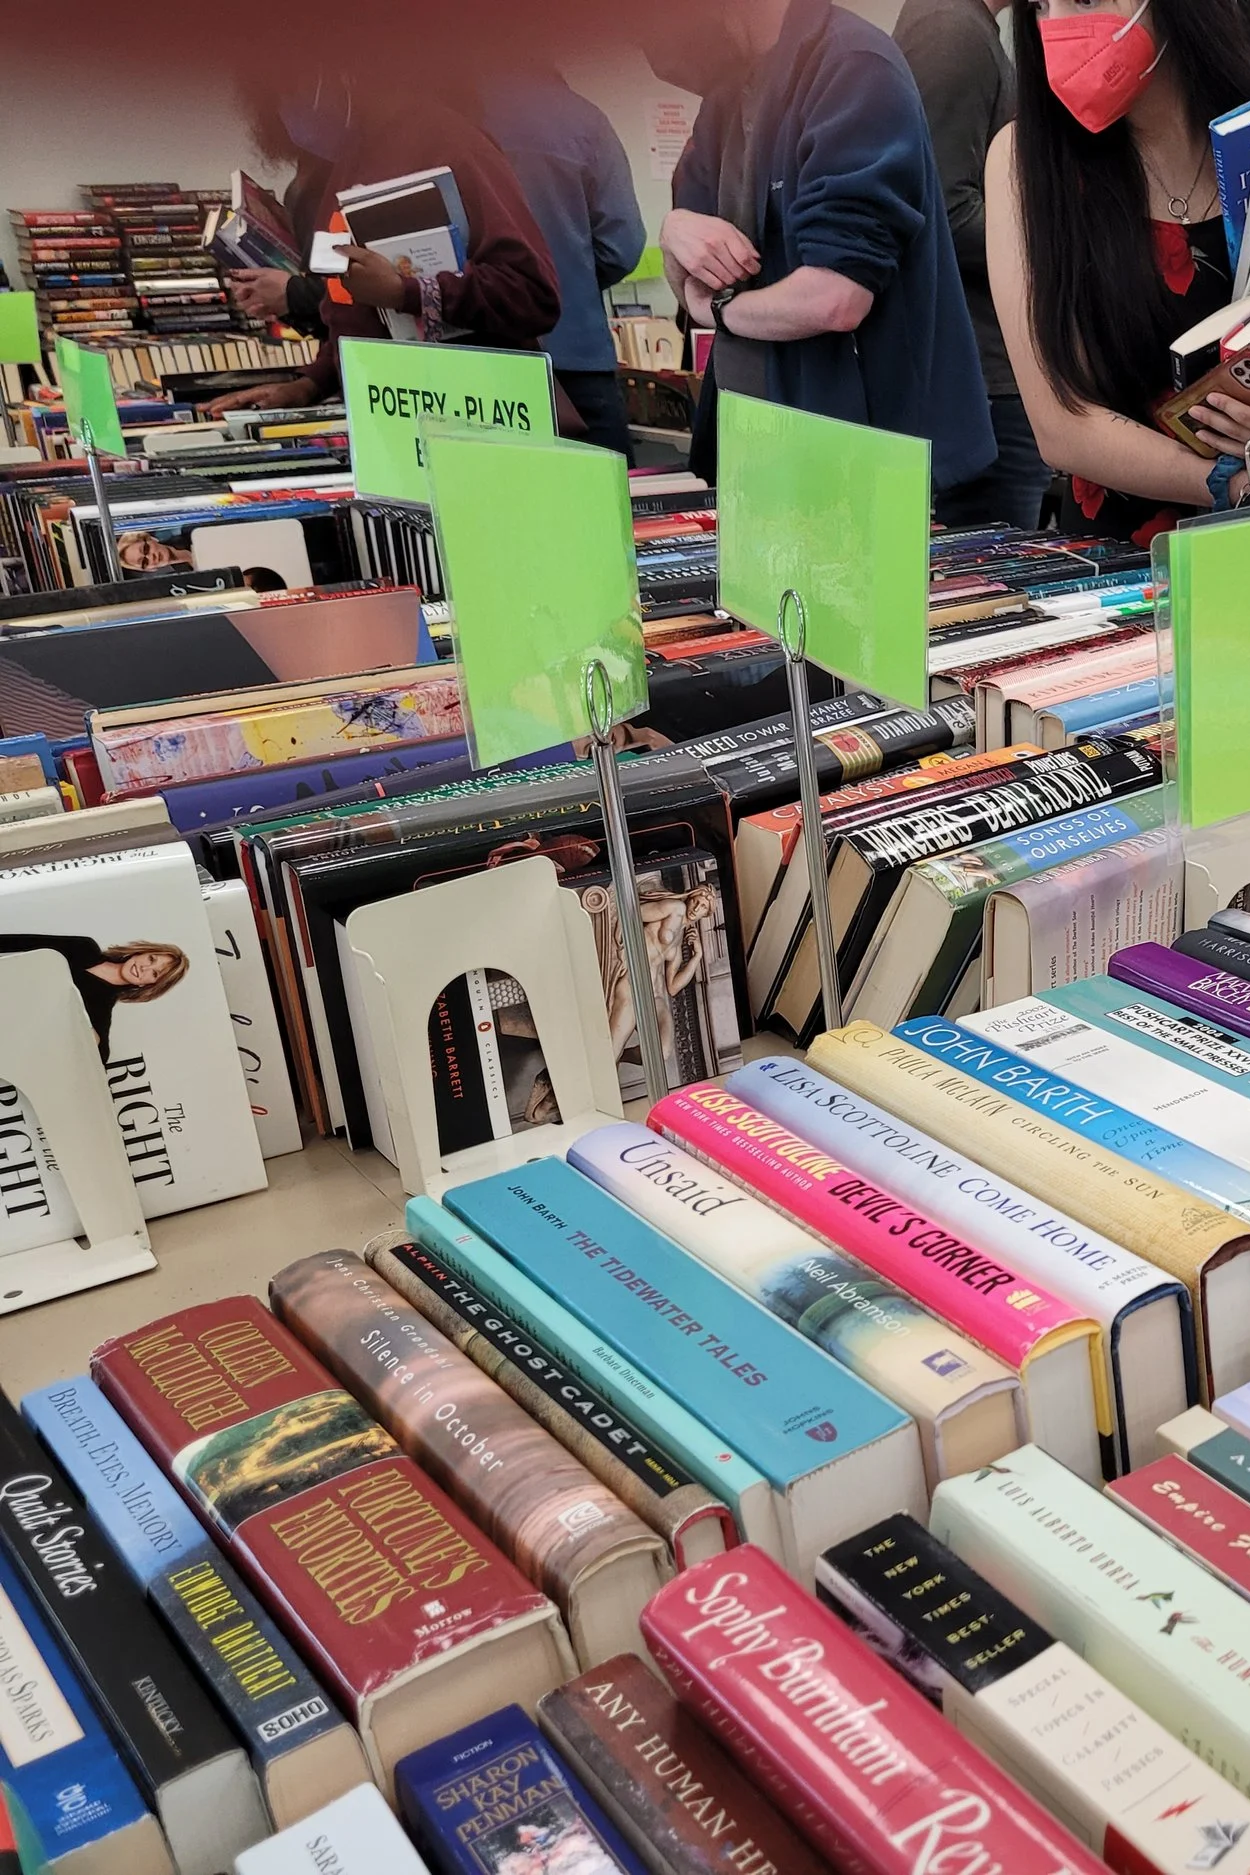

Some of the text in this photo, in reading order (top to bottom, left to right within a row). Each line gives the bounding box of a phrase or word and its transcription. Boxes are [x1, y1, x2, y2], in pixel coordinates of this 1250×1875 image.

[368, 385, 531, 431] POETRY PLAYS
[758, 721, 791, 742] WAR
[1035, 762, 1112, 817] KOONTZ
[1029, 818, 1129, 861] OURSELVES
[1112, 1010, 1249, 1075] BEST SMALL PRESSES
[1129, 1004, 1195, 1037] PUSHCART
[1192, 1022, 1223, 1039] 2004
[445, 1045, 465, 1100] BARRETT
[904, 1024, 1116, 1125] JOHN BARTH
[1152, 1088, 1209, 1111] HENDERSON
[105, 1053, 175, 1189] RIGHT
[931, 1071, 1165, 1200] MCLAIN CIRCLING SUN
[619, 1139, 746, 1219] Unsaid
[688, 1087, 1016, 1296] LISA SCOTTOLINE DEVIL'S CORNER
[815, 1094, 1117, 1271] SCOTTOLINE COME HOME
[325, 1257, 401, 1323] Jens Christian
[507, 1184, 771, 1389] JOHN BARTH THE TIDEWATER TALES
[827, 1276, 912, 1339] Abramson
[123, 1324, 250, 1432] McCULLOUGH
[197, 1320, 298, 1389] COLLEEN
[402, 1242, 649, 1457] ALPHIN THE GHOST CADET
[359, 1329, 505, 1474] Silence October
[48, 1386, 184, 1557] BREATH, EYES, MEMORY
[0, 1474, 105, 1598] Quilt Stories
[337, 1466, 491, 1591] FORTUNE'S
[1028, 1500, 1094, 1555] ALBERTO
[270, 1497, 419, 1627] FAVORITES
[167, 1561, 298, 1701] EDWIDGE DANTICAT
[412, 1605, 473, 1639] Morrow
[922, 1590, 973, 1624] TIMES
[131, 1674, 185, 1737] KENTUCKY
[680, 1571, 910, 1788] Sophy Burnham
[261, 1699, 327, 1738] SOHO
[452, 1738, 495, 1763] FICTION
[434, 1745, 541, 1812] SHARON
[585, 1680, 738, 1840] ANY HUMAN
[455, 1775, 565, 1843] PENMAN
